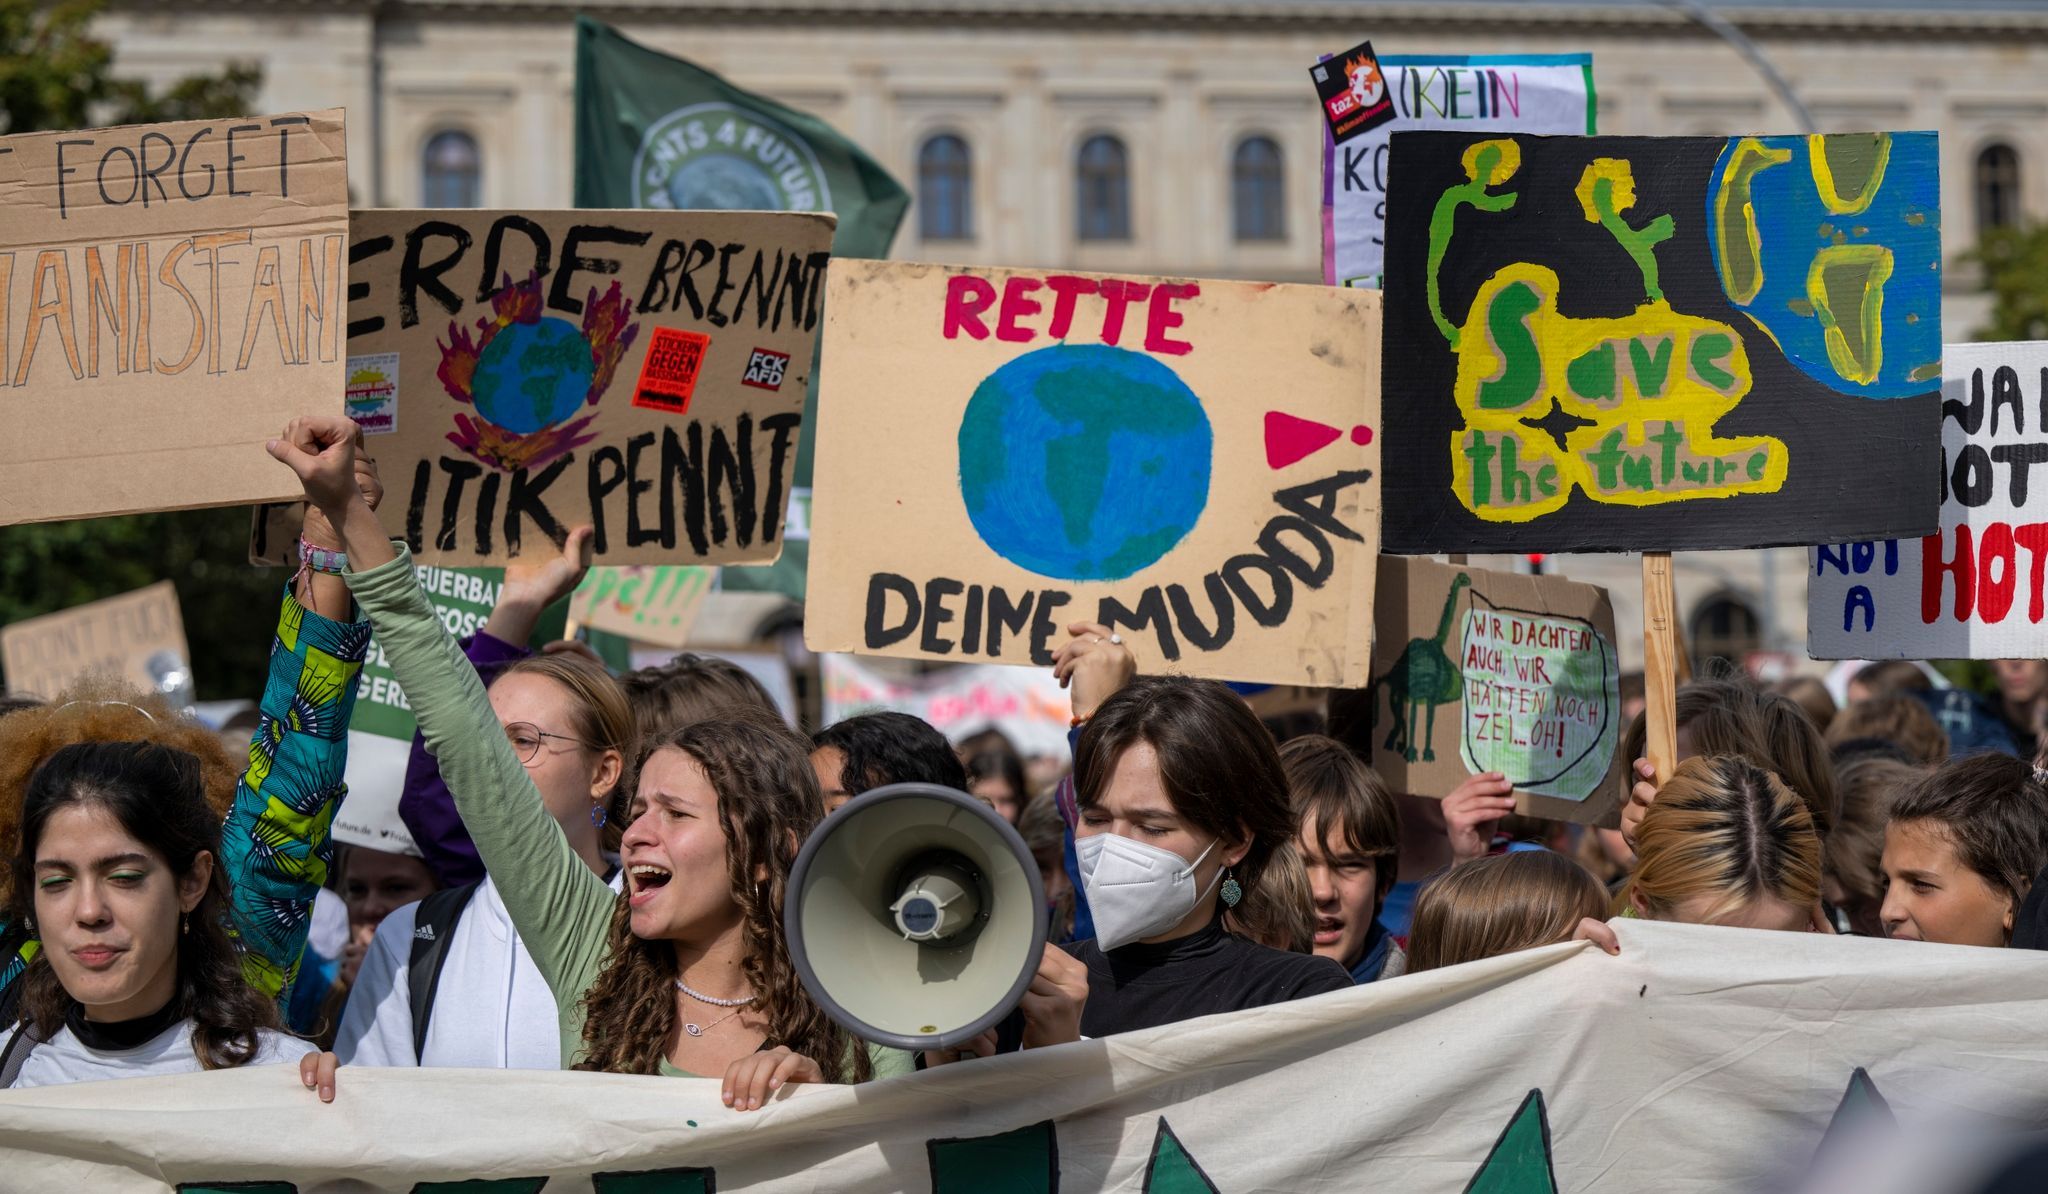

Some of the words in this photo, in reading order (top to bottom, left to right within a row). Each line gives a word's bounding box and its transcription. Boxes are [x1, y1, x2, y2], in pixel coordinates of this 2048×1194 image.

[1331, 96, 1354, 115] taz
[56, 116, 310, 219] FORGET
[648, 120, 709, 208] ENTS
[716, 118, 737, 147] 4
[742, 126, 816, 209] FUTUR
[0, 228, 343, 387] ANISTAN
[346, 215, 653, 339] ERDE
[636, 239, 830, 333] BRENNT
[942, 274, 1201, 356] RETTE
[1479, 280, 1736, 410] Save
[649, 349, 699, 373] GEGEN
[744, 367, 782, 385] AFD
[750, 351, 787, 372] FCK
[390, 452, 577, 557] ITIK
[588, 411, 801, 556] PENNT
[1466, 429, 1557, 508] the
[1587, 420, 1768, 490] future
[1941, 443, 2048, 507] OT
[414, 565, 504, 607] EUERBA
[1921, 522, 2048, 624] HOT
[435, 604, 489, 638] FOSS
[864, 572, 1072, 666] DEINE
[1473, 614, 1504, 642] WIR
[1512, 619, 1592, 652] DACHTEN
[1844, 585, 1875, 632] A
[1514, 655, 1552, 685] WIR
[1471, 679, 1546, 715] HÄTTEN
[1555, 695, 1598, 727] NOCH
